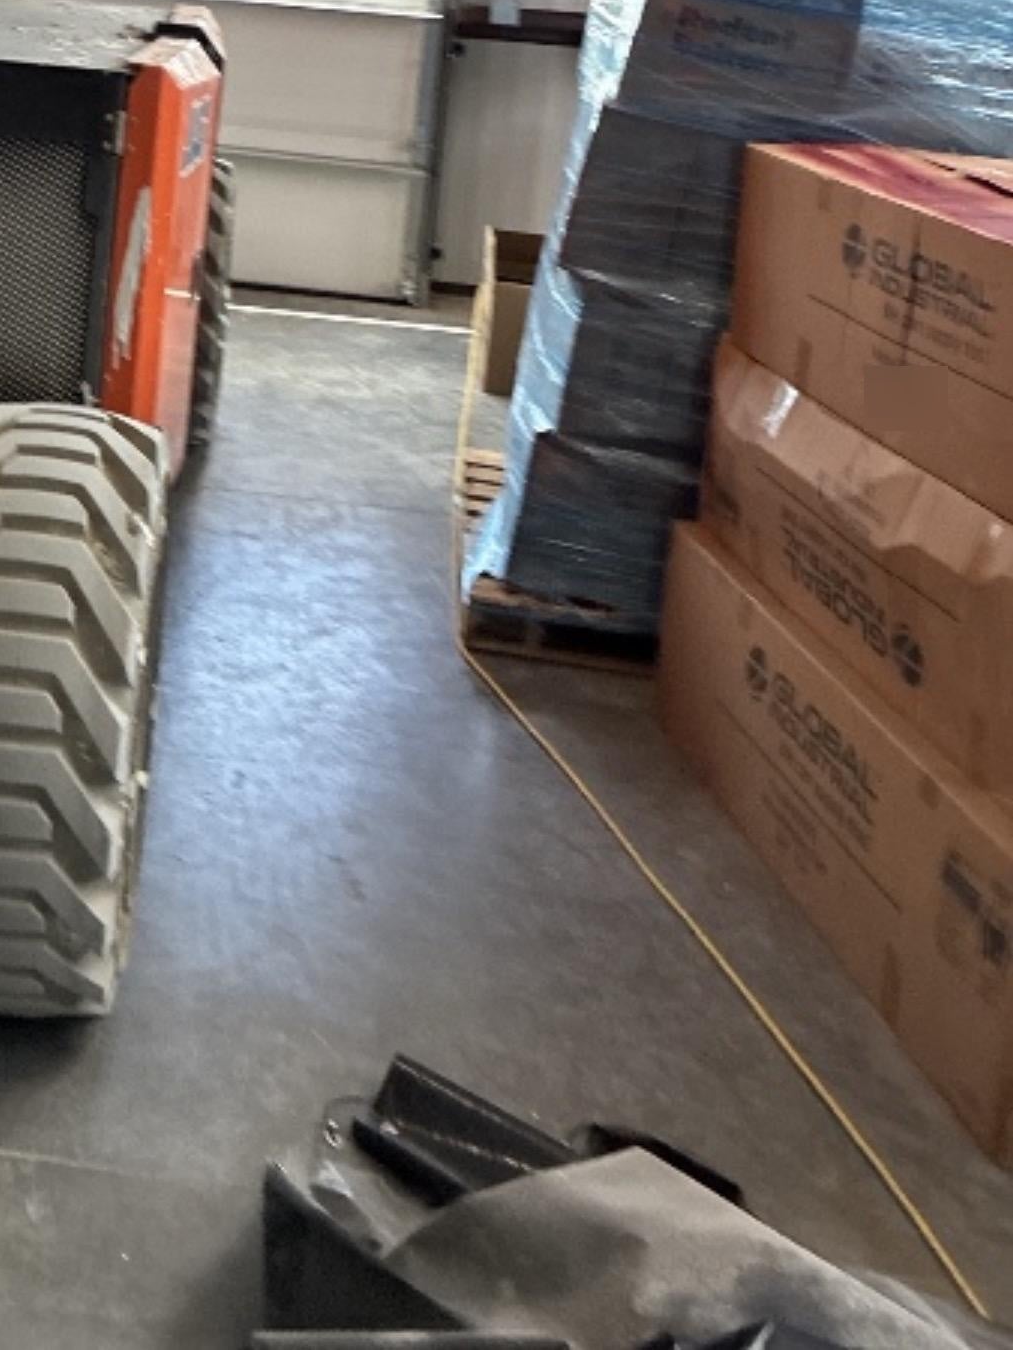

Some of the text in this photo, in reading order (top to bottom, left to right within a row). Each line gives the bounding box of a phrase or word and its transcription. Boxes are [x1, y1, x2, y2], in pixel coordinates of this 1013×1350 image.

[873, 238, 996, 312] GLOBAL
[783, 546, 889, 659] GLOBAL
[772, 672, 879, 800] GLOBAL
